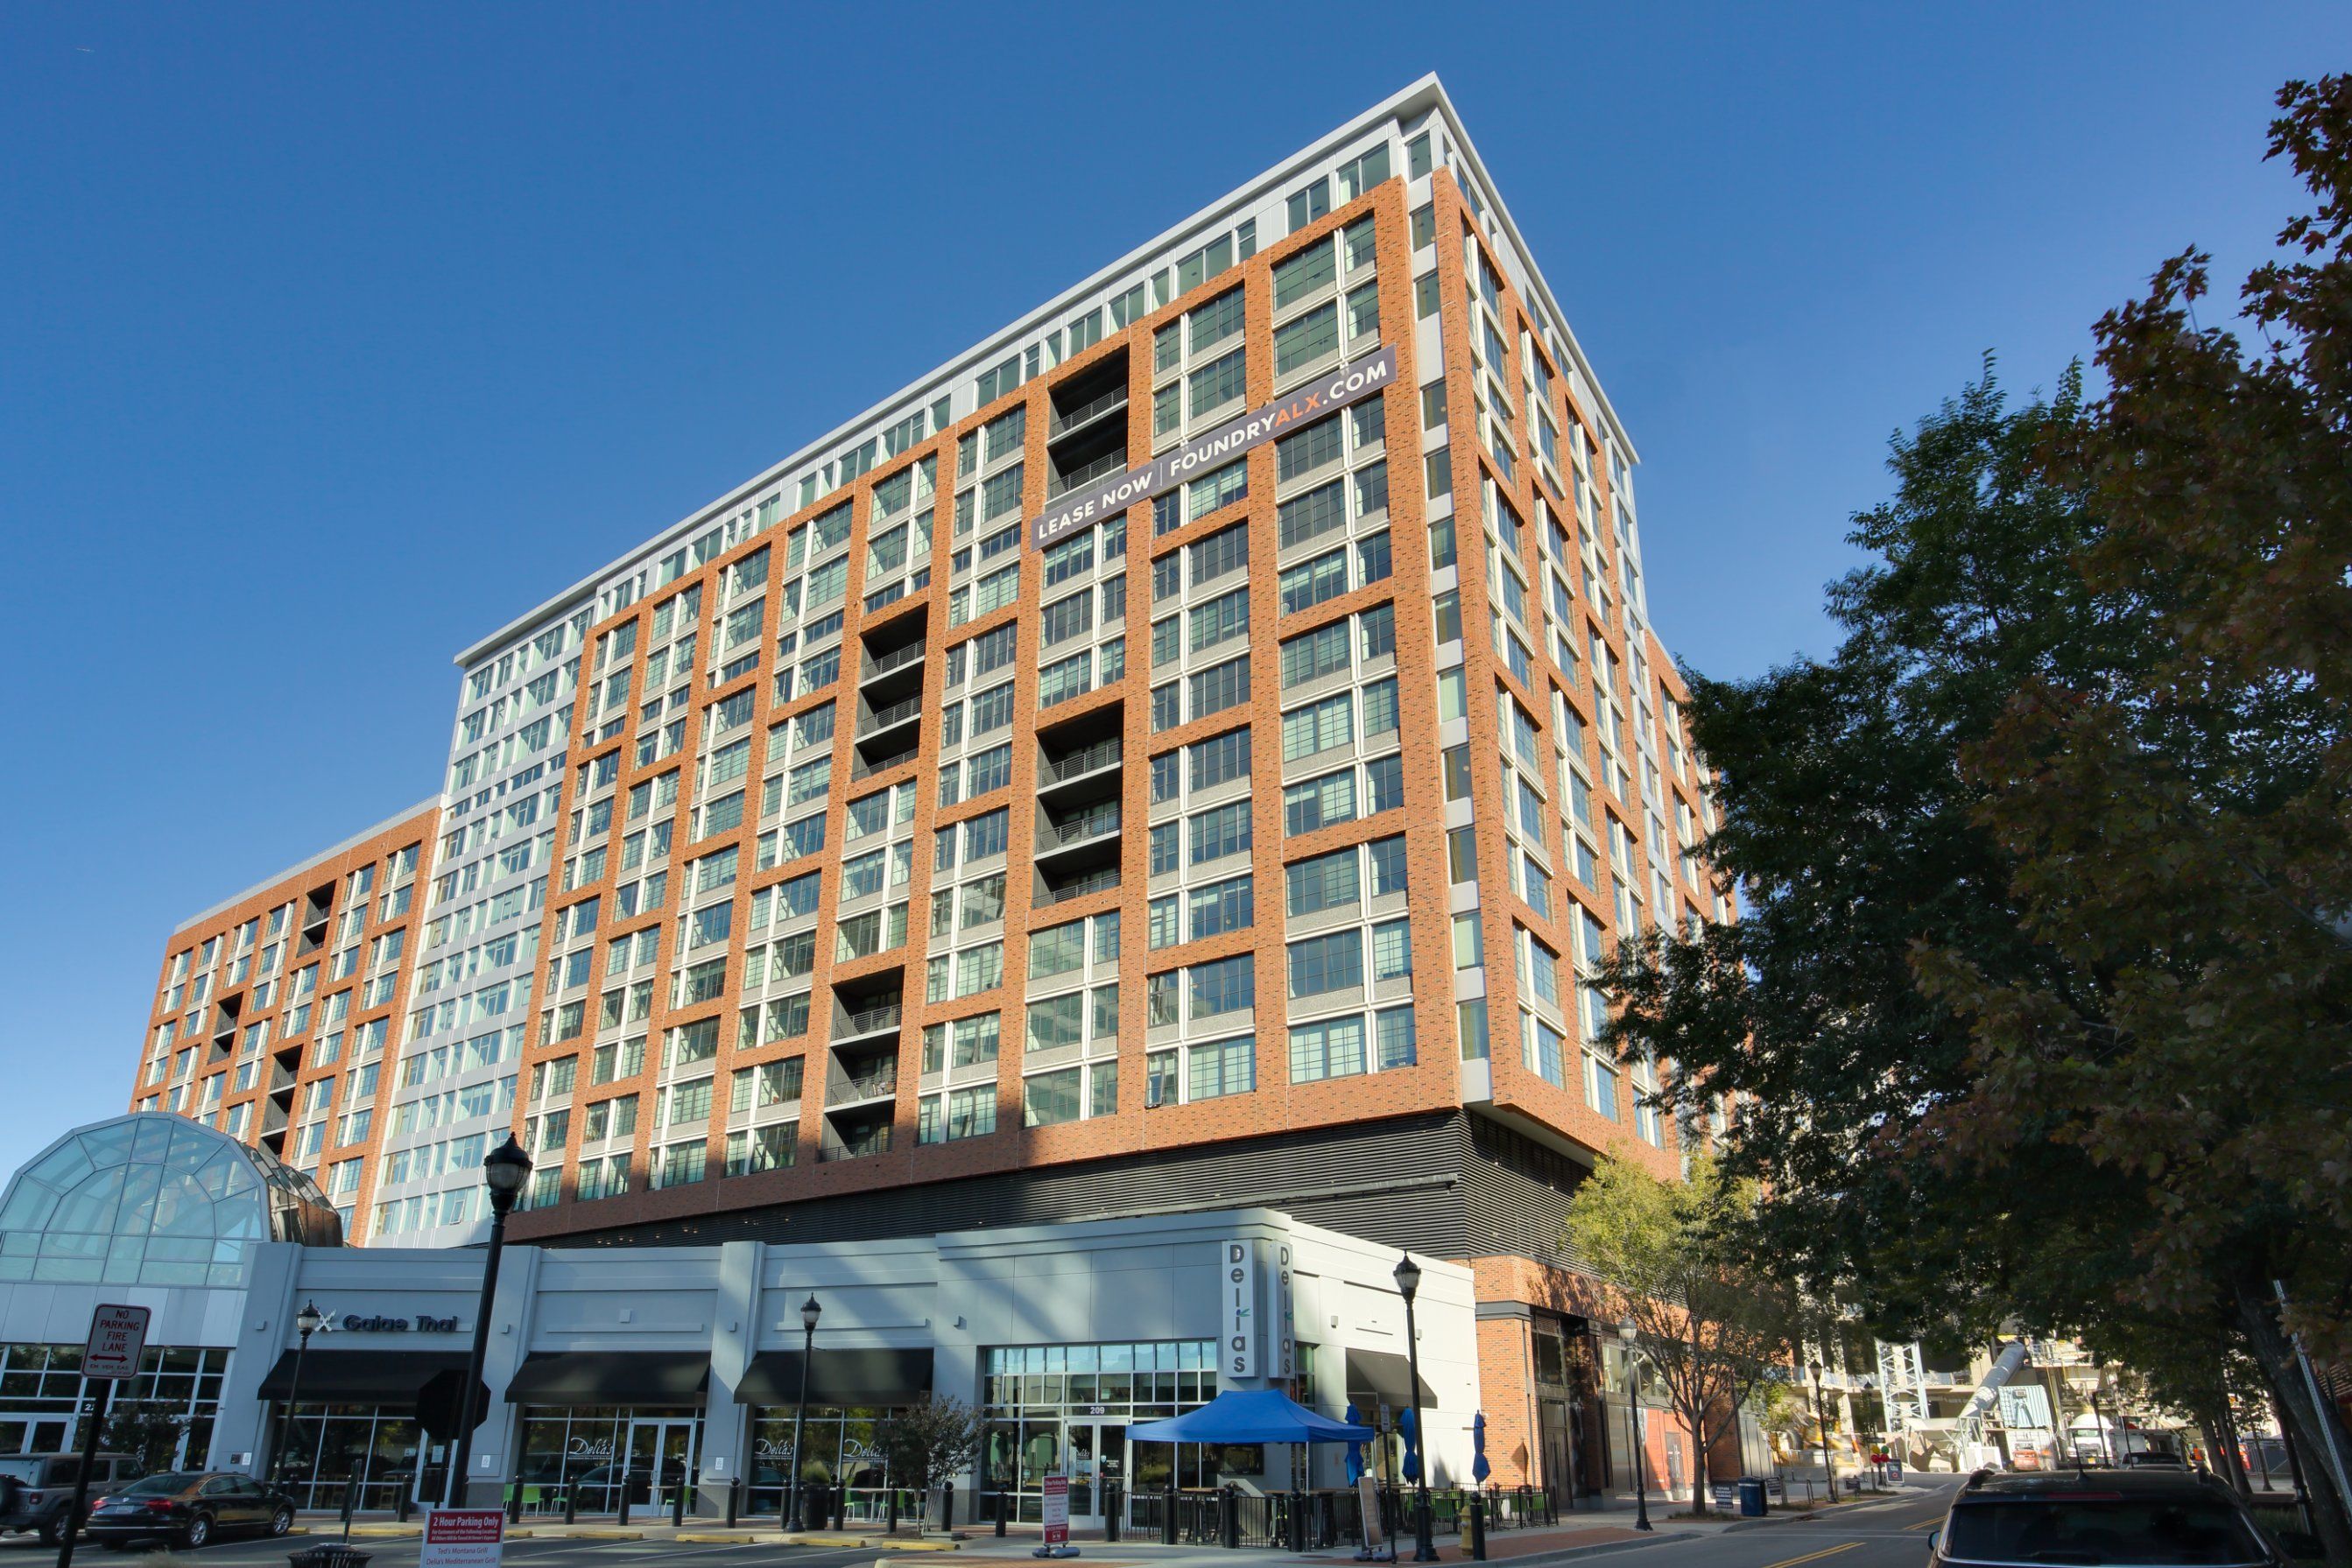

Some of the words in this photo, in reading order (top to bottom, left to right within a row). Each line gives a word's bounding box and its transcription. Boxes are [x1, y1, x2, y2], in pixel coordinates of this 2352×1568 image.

[1039, 500, 1095, 539] LEASE
[1102, 472, 1152, 509] NOW
[1170, 360, 1387, 477] FOUNDRYALX.COM
[116, 1310, 129, 1318] NO
[100, 1320, 140, 1331] PARKING
[342, 1314, 409, 1332] Galae
[107, 1331, 129, 1341] FIRE
[102, 1343, 128, 1353] LANE
[1090, 1406, 1105, 1415] 209
[433, 1517, 438, 1526] 2
[439, 1517, 455, 1526] Hour
[456, 1517, 482, 1529] Parking
[483, 1516, 499, 1528] Only
